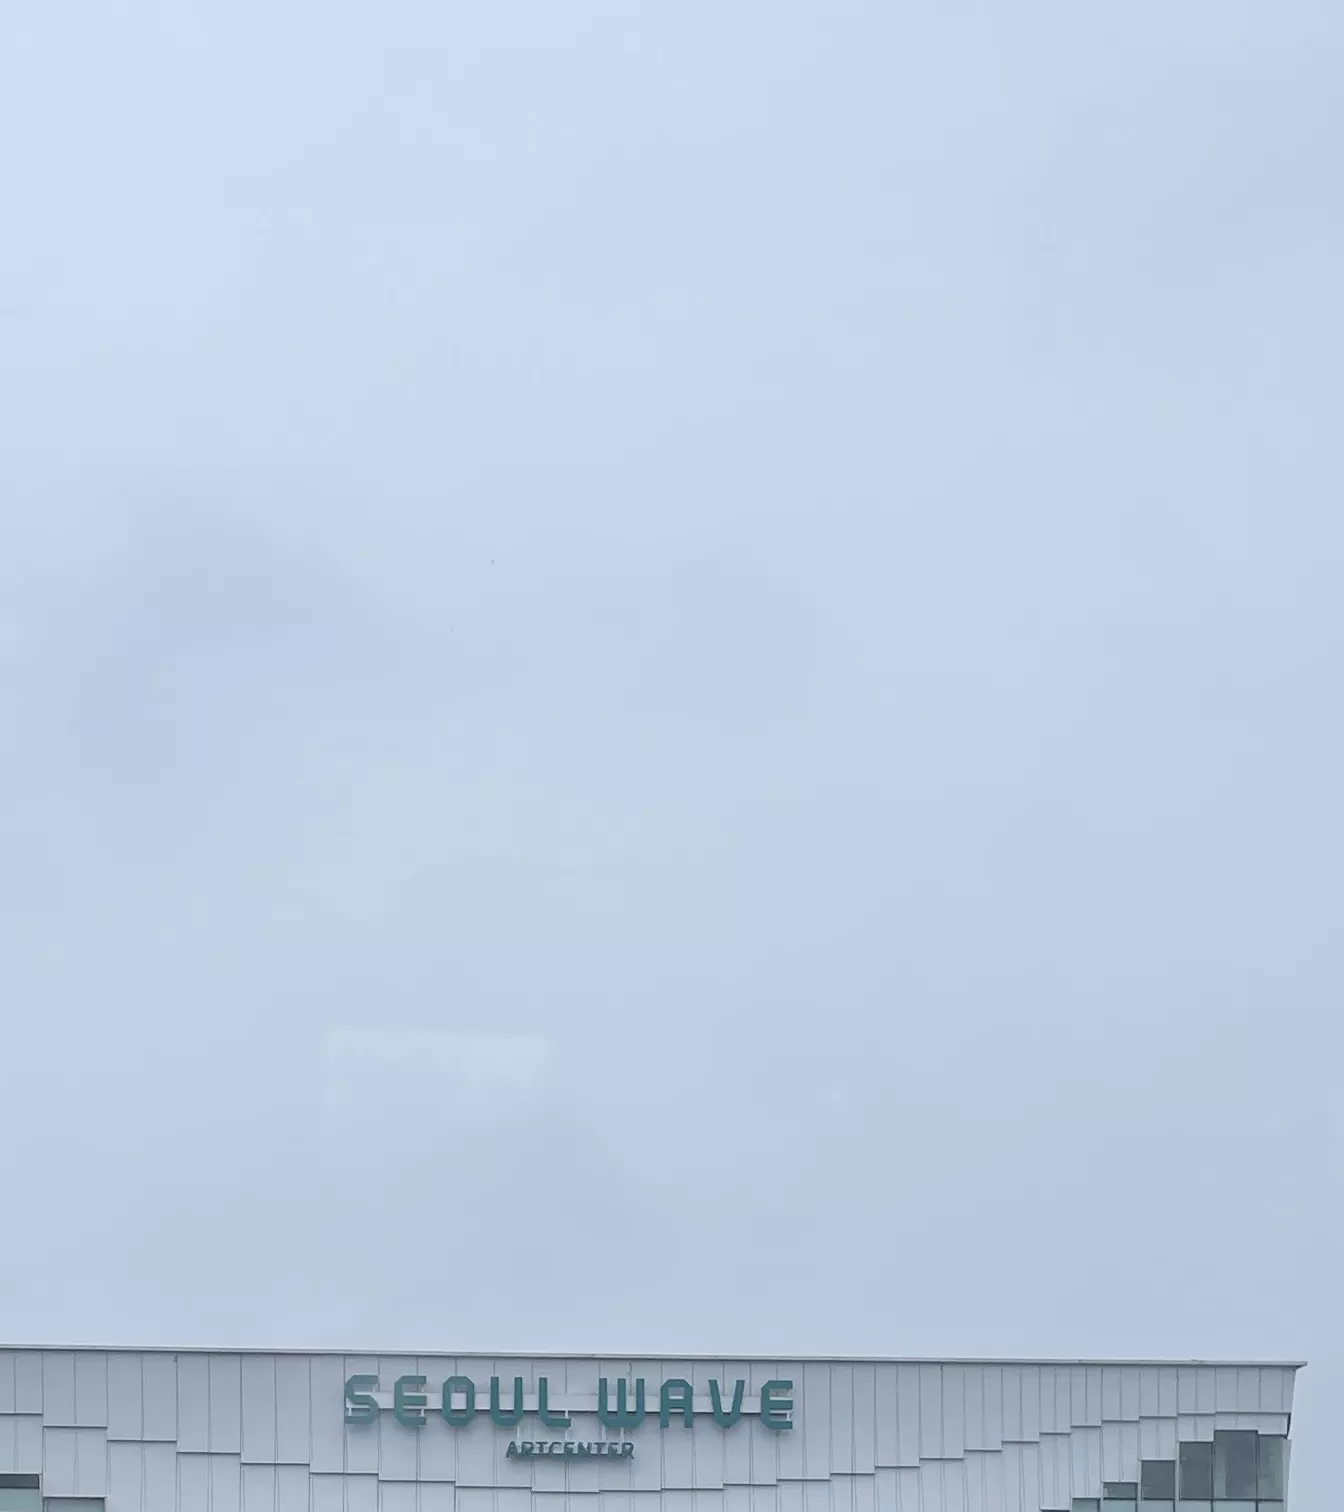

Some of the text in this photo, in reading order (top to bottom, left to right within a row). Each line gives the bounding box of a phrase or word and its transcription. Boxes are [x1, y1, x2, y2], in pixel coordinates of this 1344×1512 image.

[344, 1374, 794, 1431] SEOUL WAVE
[504, 1440, 635, 1460] ARTCENTER
